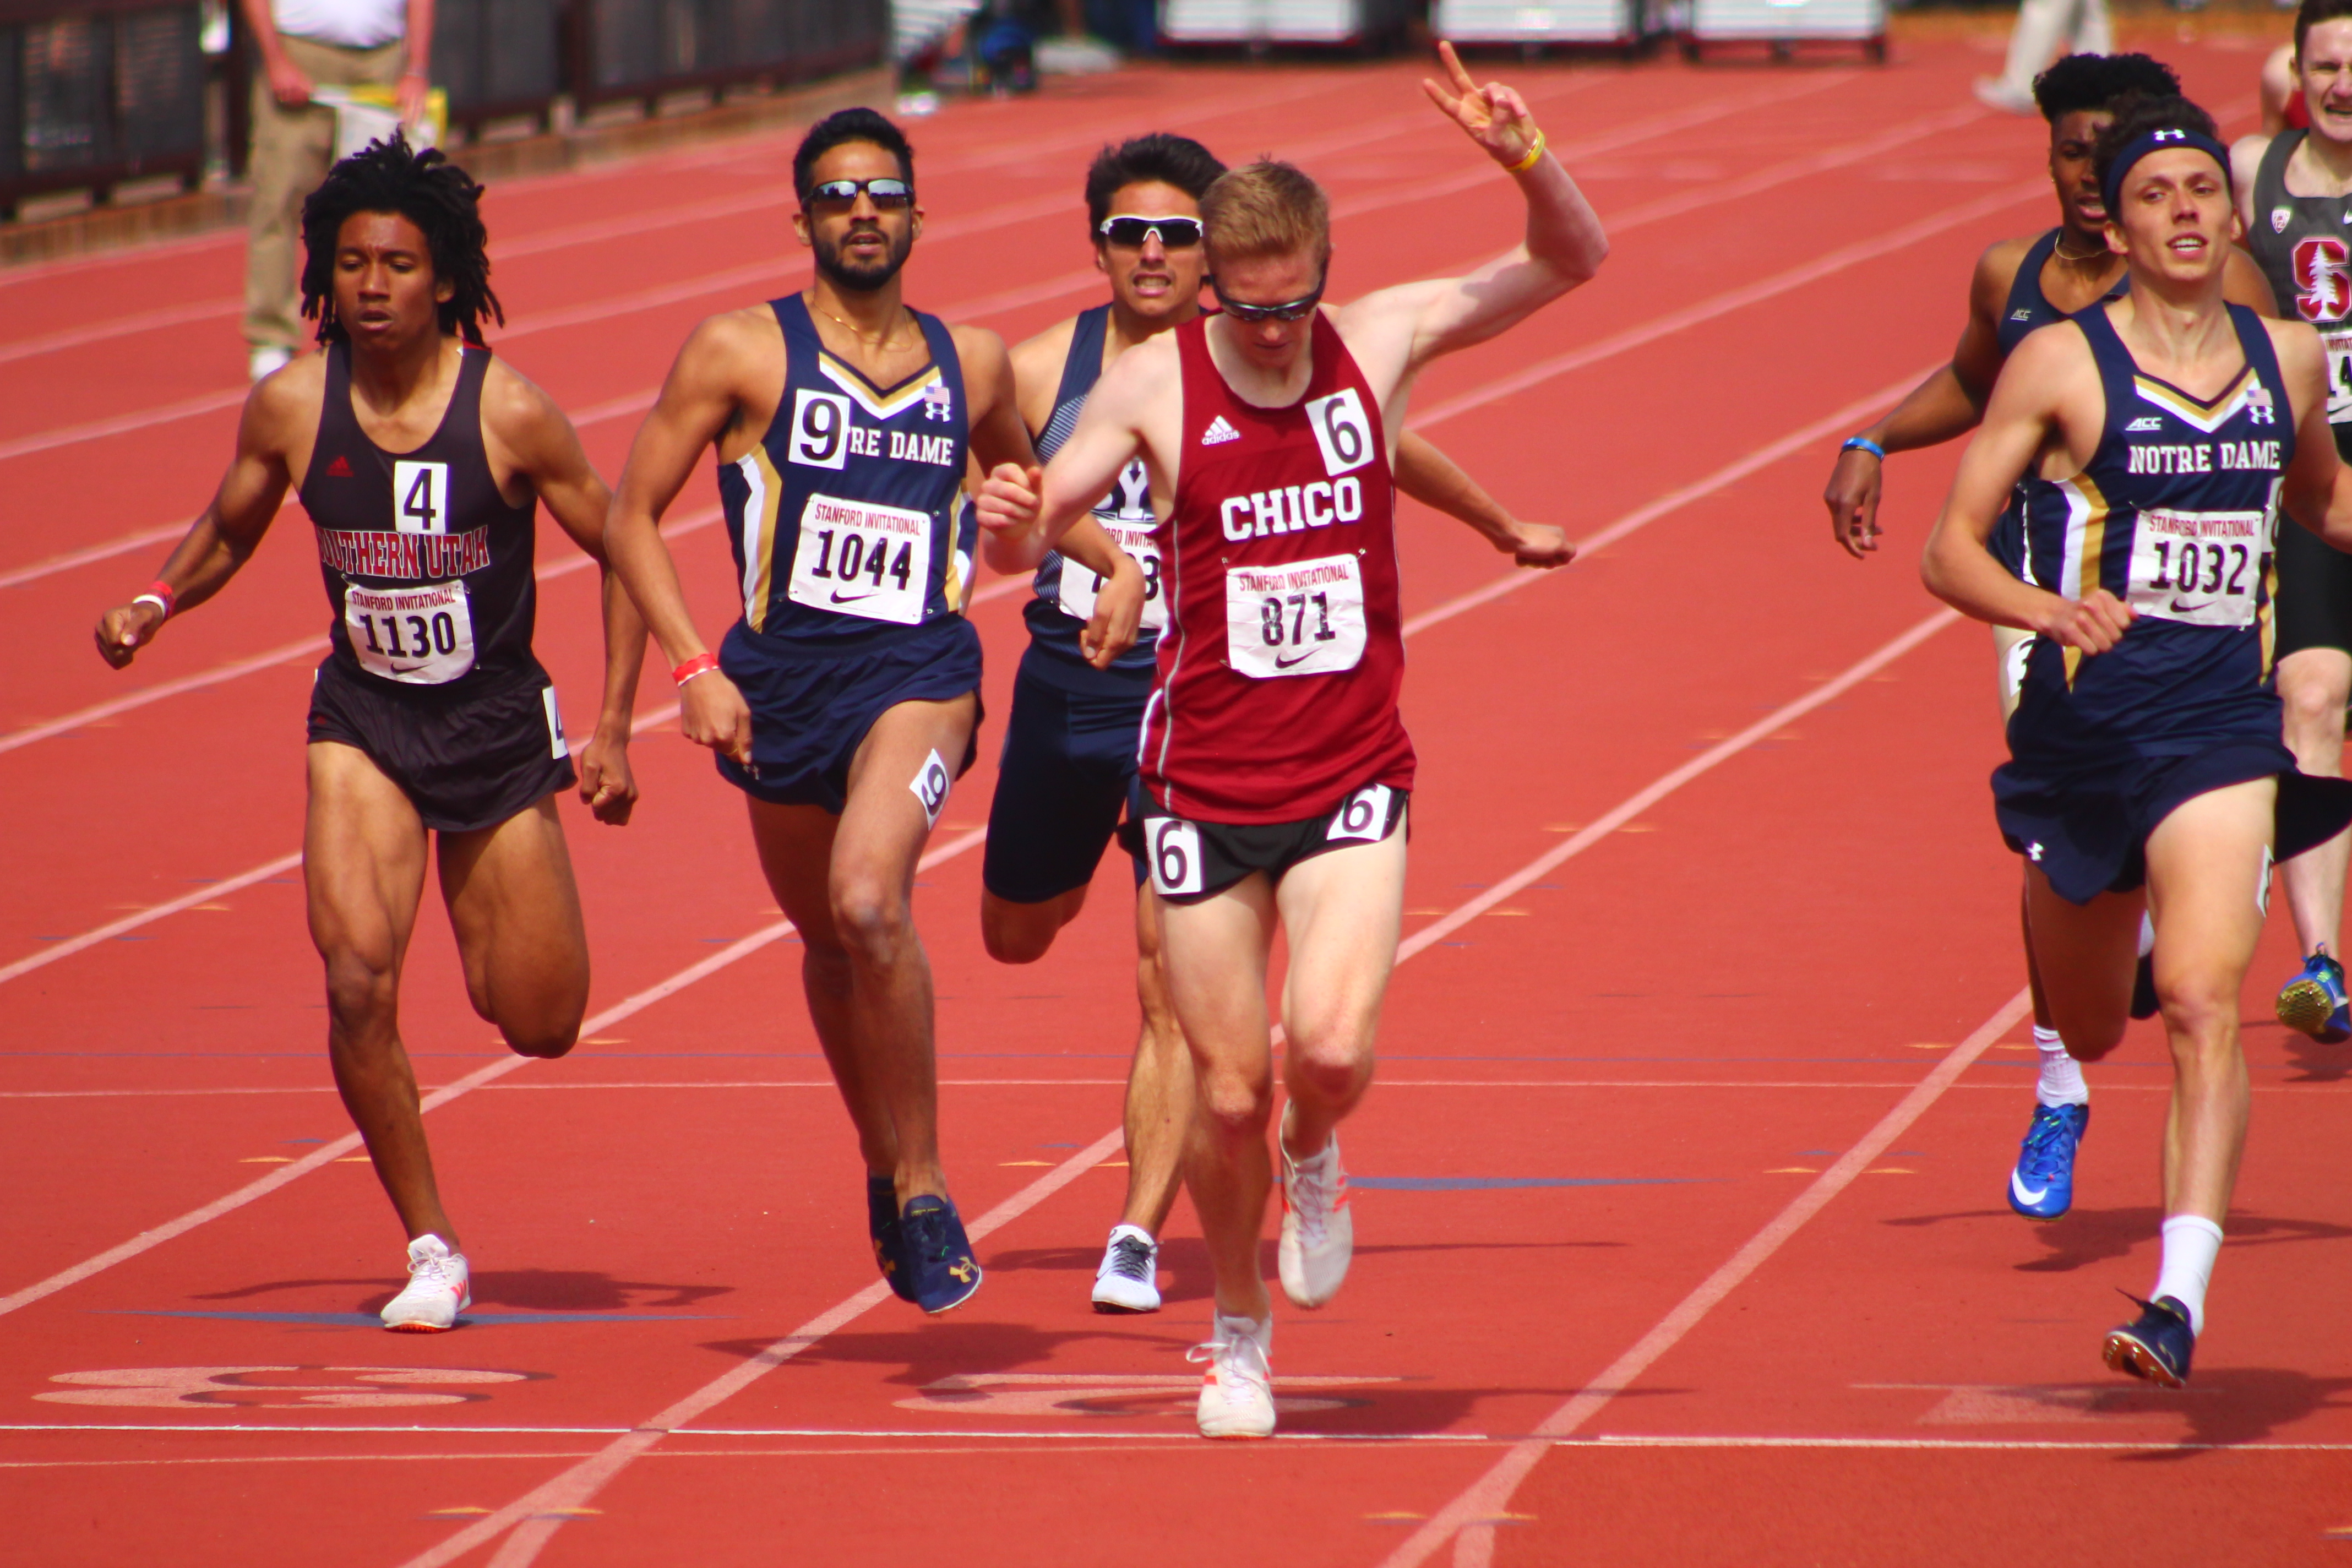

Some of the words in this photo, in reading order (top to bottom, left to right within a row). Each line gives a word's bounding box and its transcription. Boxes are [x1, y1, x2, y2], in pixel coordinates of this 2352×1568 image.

[2011, 308, 2032, 319] ACC
[800, 398, 841, 461] 9
[889, 431, 954, 466] DAME
[1201, 429, 1240, 445] adidas
[1324, 398, 1363, 464] 6
[2127, 417, 2163, 429] ACC
[2128, 444, 2212, 474] NOTRE
[2219, 440, 2281, 470] DAME
[403, 468, 437, 531] 4
[815, 503, 863, 527] STANFORD
[864, 512, 921, 536] INVITATIONAL
[1221, 476, 1363, 541] CHICO
[424, 525, 491, 578] UTAH
[812, 530, 912, 591] 1044
[2149, 541, 2248, 595] 1032
[352, 591, 393, 611] STANFORD
[395, 589, 456, 611] INVITATIONAL
[1239, 574, 1286, 592] STANFORD
[1287, 564, 1349, 590] INVITATIONAL
[359, 612, 456, 658] 1130
[1261, 591, 1336, 646] 871
[921, 763, 946, 816] 9
[1341, 784, 1379, 833] 6
[1156, 820, 1188, 889] 6
